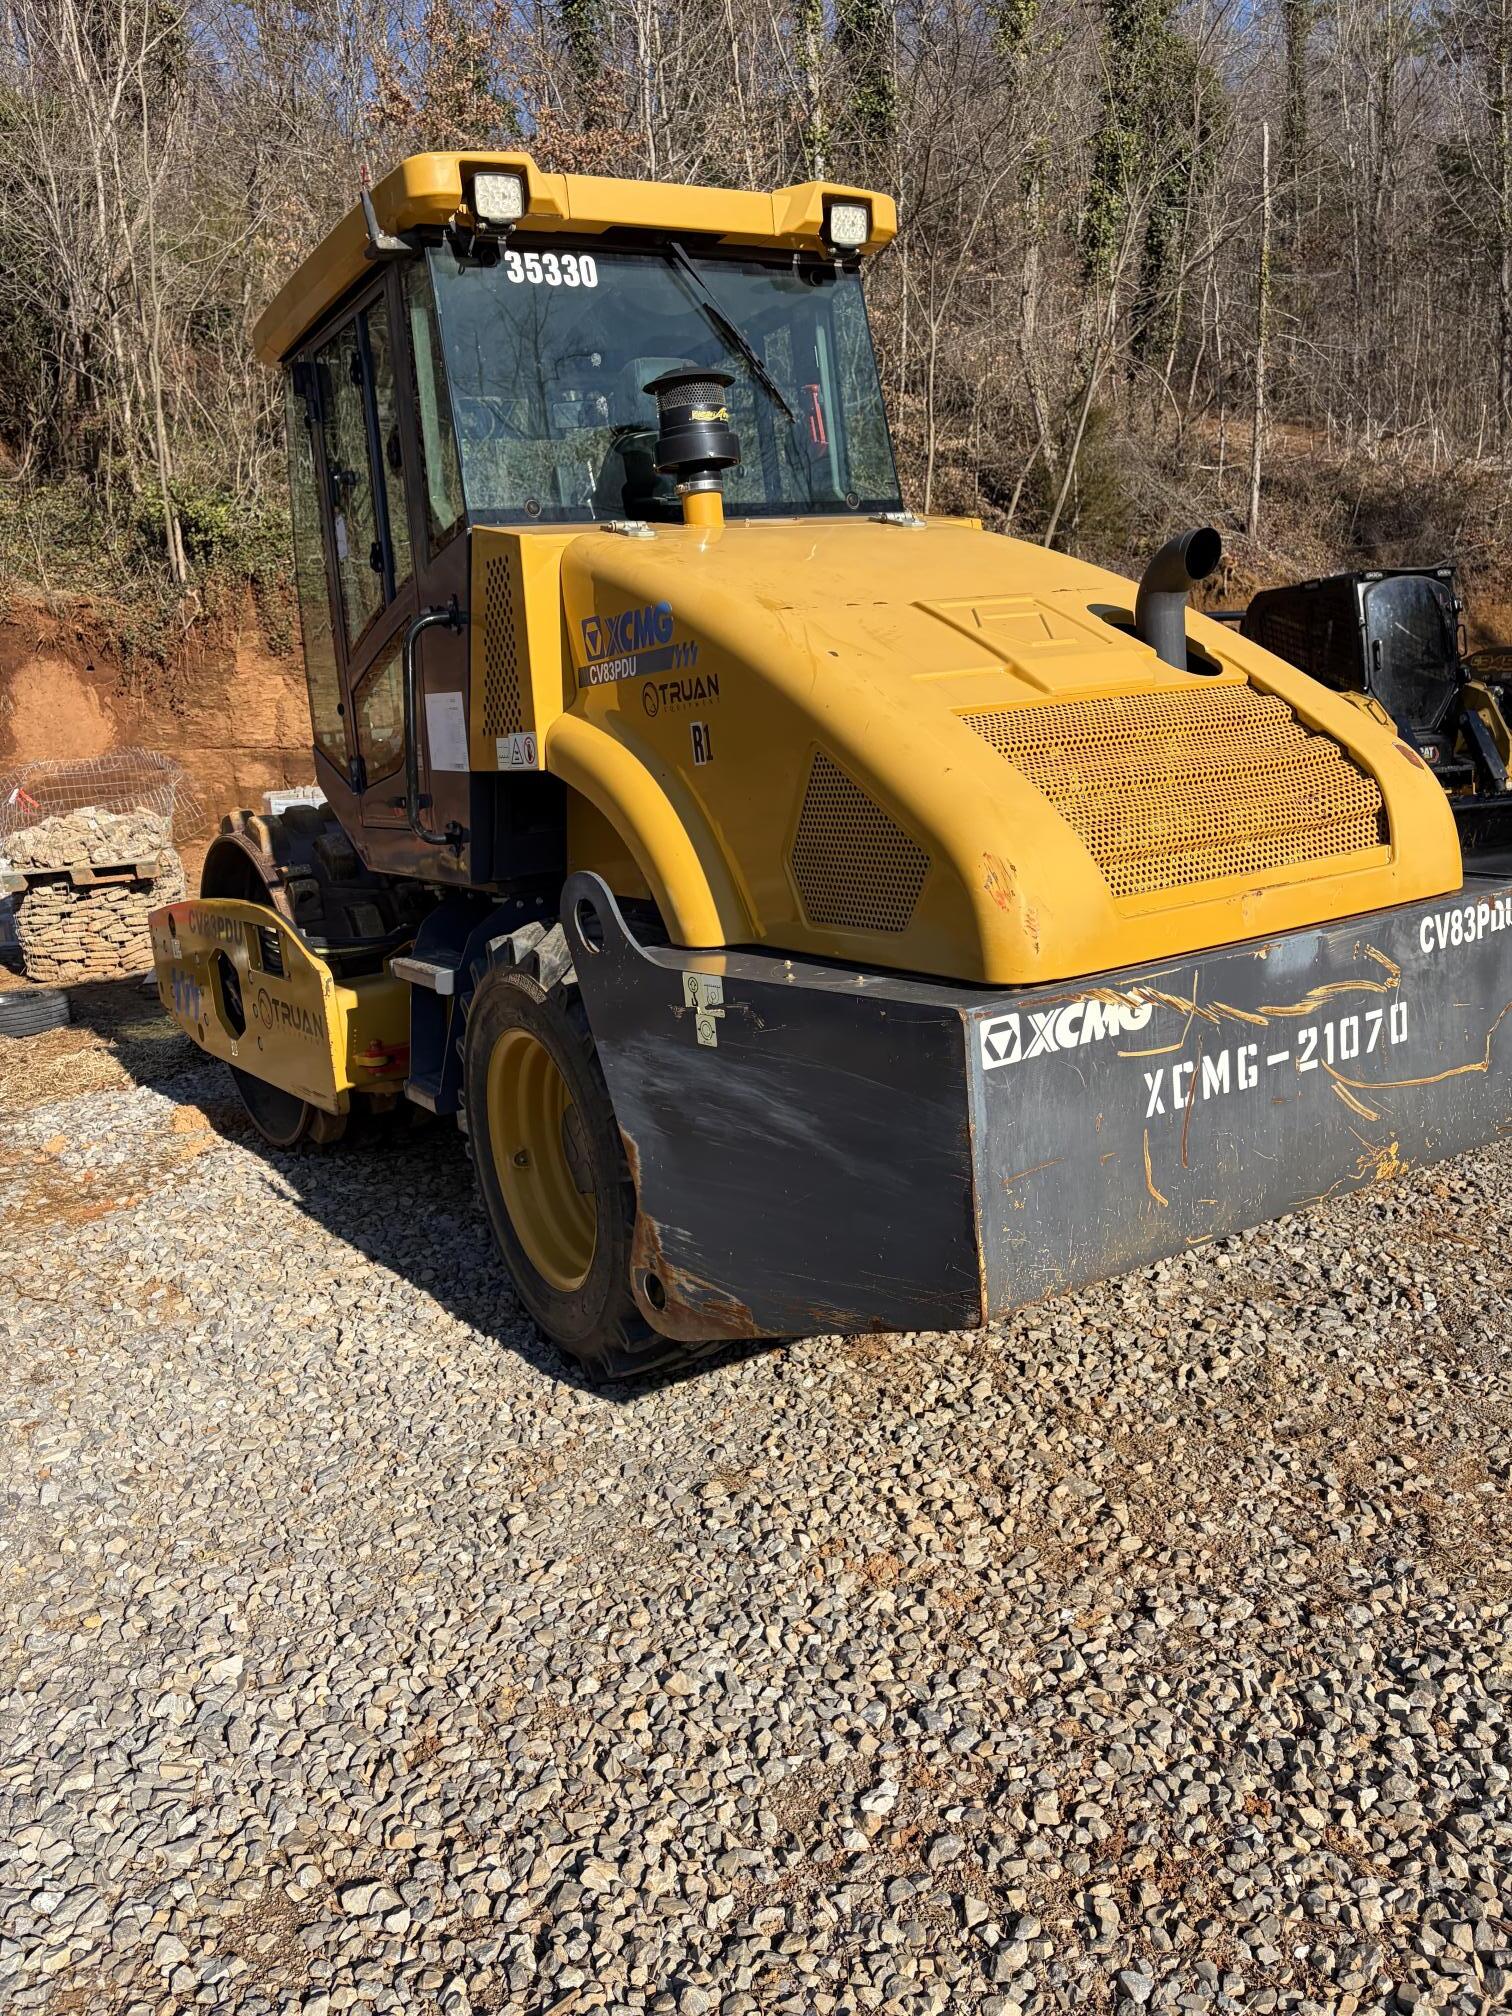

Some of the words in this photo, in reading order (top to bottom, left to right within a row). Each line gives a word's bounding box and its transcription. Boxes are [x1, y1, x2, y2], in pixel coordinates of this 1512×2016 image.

[504, 250, 598, 288] 35330
[604, 600, 674, 656] XCMG
[589, 656, 637, 685] CV83PDU
[658, 673, 720, 705] TRUAN
[691, 723, 714, 764] R1
[271, 998, 324, 1041] TRUAN
[1021, 991, 1153, 1060] XCMG
[1143, 1001, 1409, 1119] XCMG-21070
